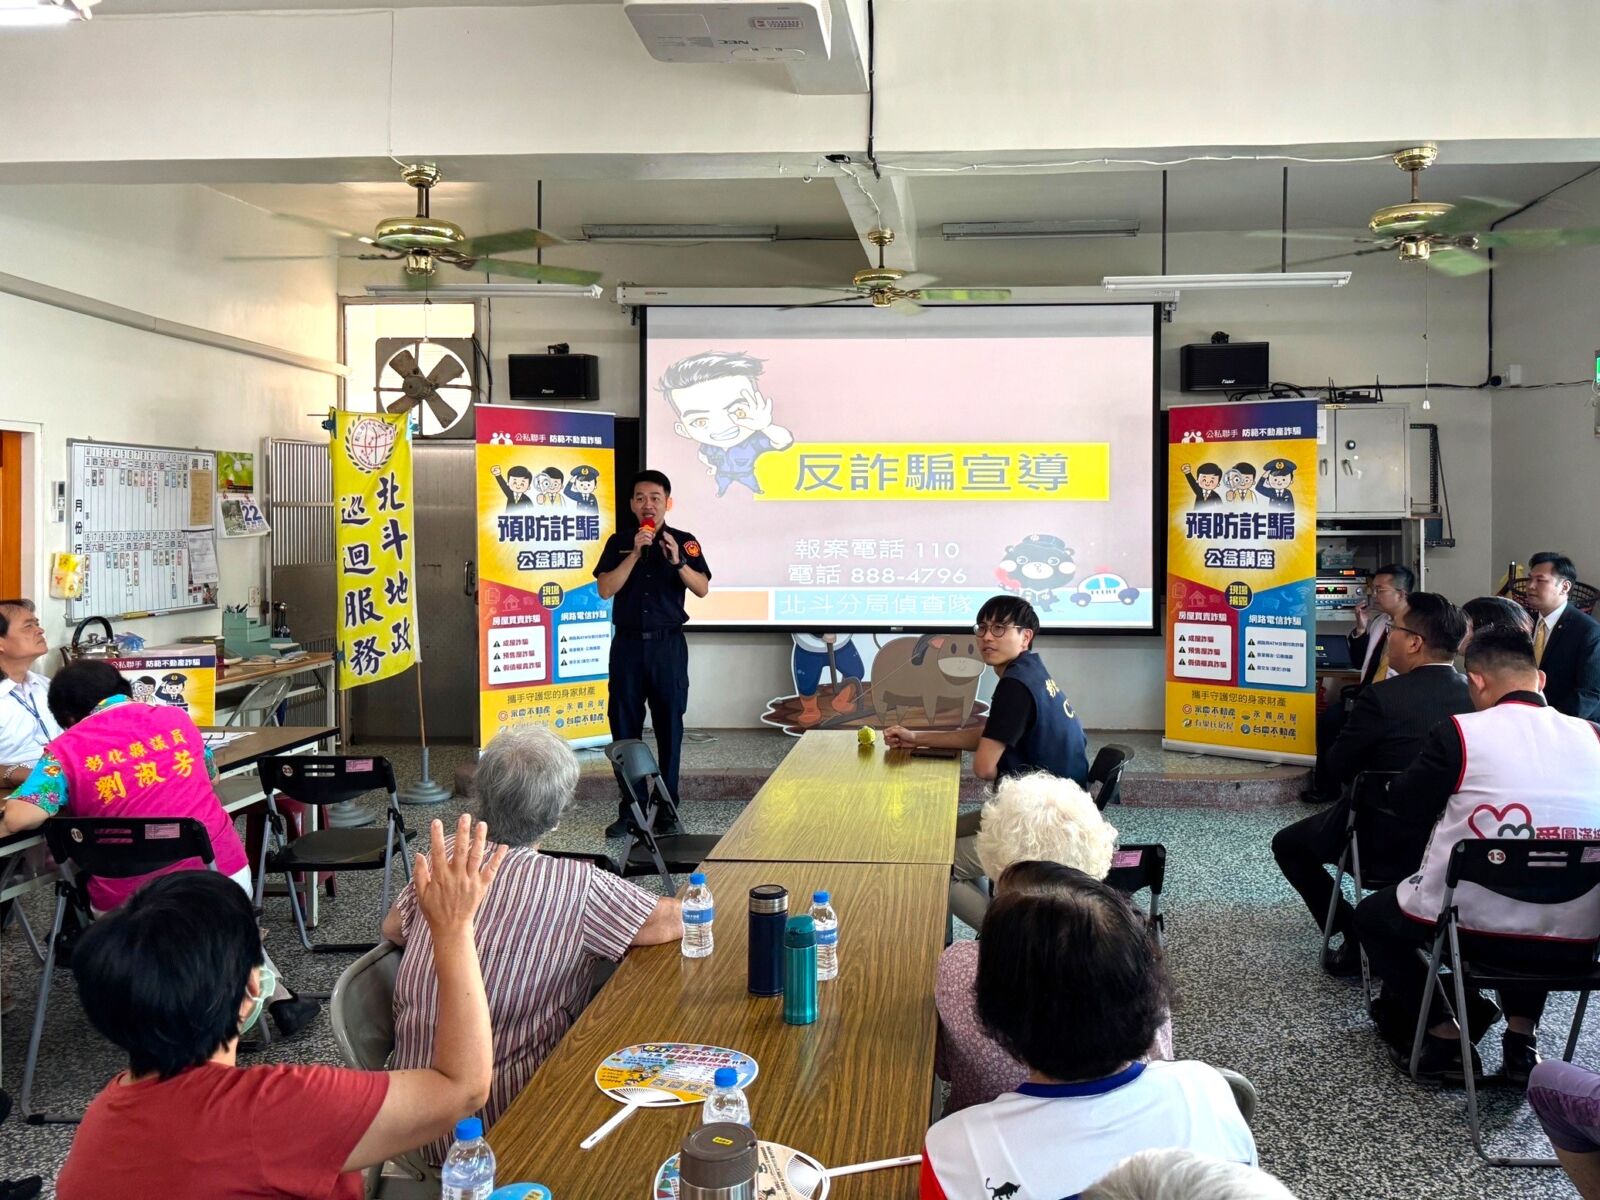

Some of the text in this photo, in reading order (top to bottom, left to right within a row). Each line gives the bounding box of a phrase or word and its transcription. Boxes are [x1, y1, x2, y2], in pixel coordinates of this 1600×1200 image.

[514, 432, 546, 442] 公私聯手
[1206, 427, 1301, 438] 公私聯手 防範不動產詐騙
[794, 452, 1068, 493] 反詐騙宣導
[242, 506, 262, 521] 22
[498, 515, 600, 542] 預防詐騙
[1186, 512, 1295, 540] 預防詐騙
[795, 538, 960, 560] 報案電話 110
[1206, 550, 1273, 568] 公益講座
[377, 472, 411, 654] 北斗地政
[519, 552, 582, 568] 公益講座
[788, 564, 968, 584] 電話 888-4796
[341, 495, 386, 676] 巡迴服務
[781, 594, 974, 615] 北斗分局偵查隊
[146, 659, 200, 668] 防範不動產詐騙
[507, 686, 596, 704] 攜手守護您的身家財產
[1192, 690, 1286, 707] 攜手守護您的身家財產
[85, 728, 188, 772] 彰化縣議員
[95, 749, 194, 806] 劉淑芳
[1488, 852, 1504, 861] 13
